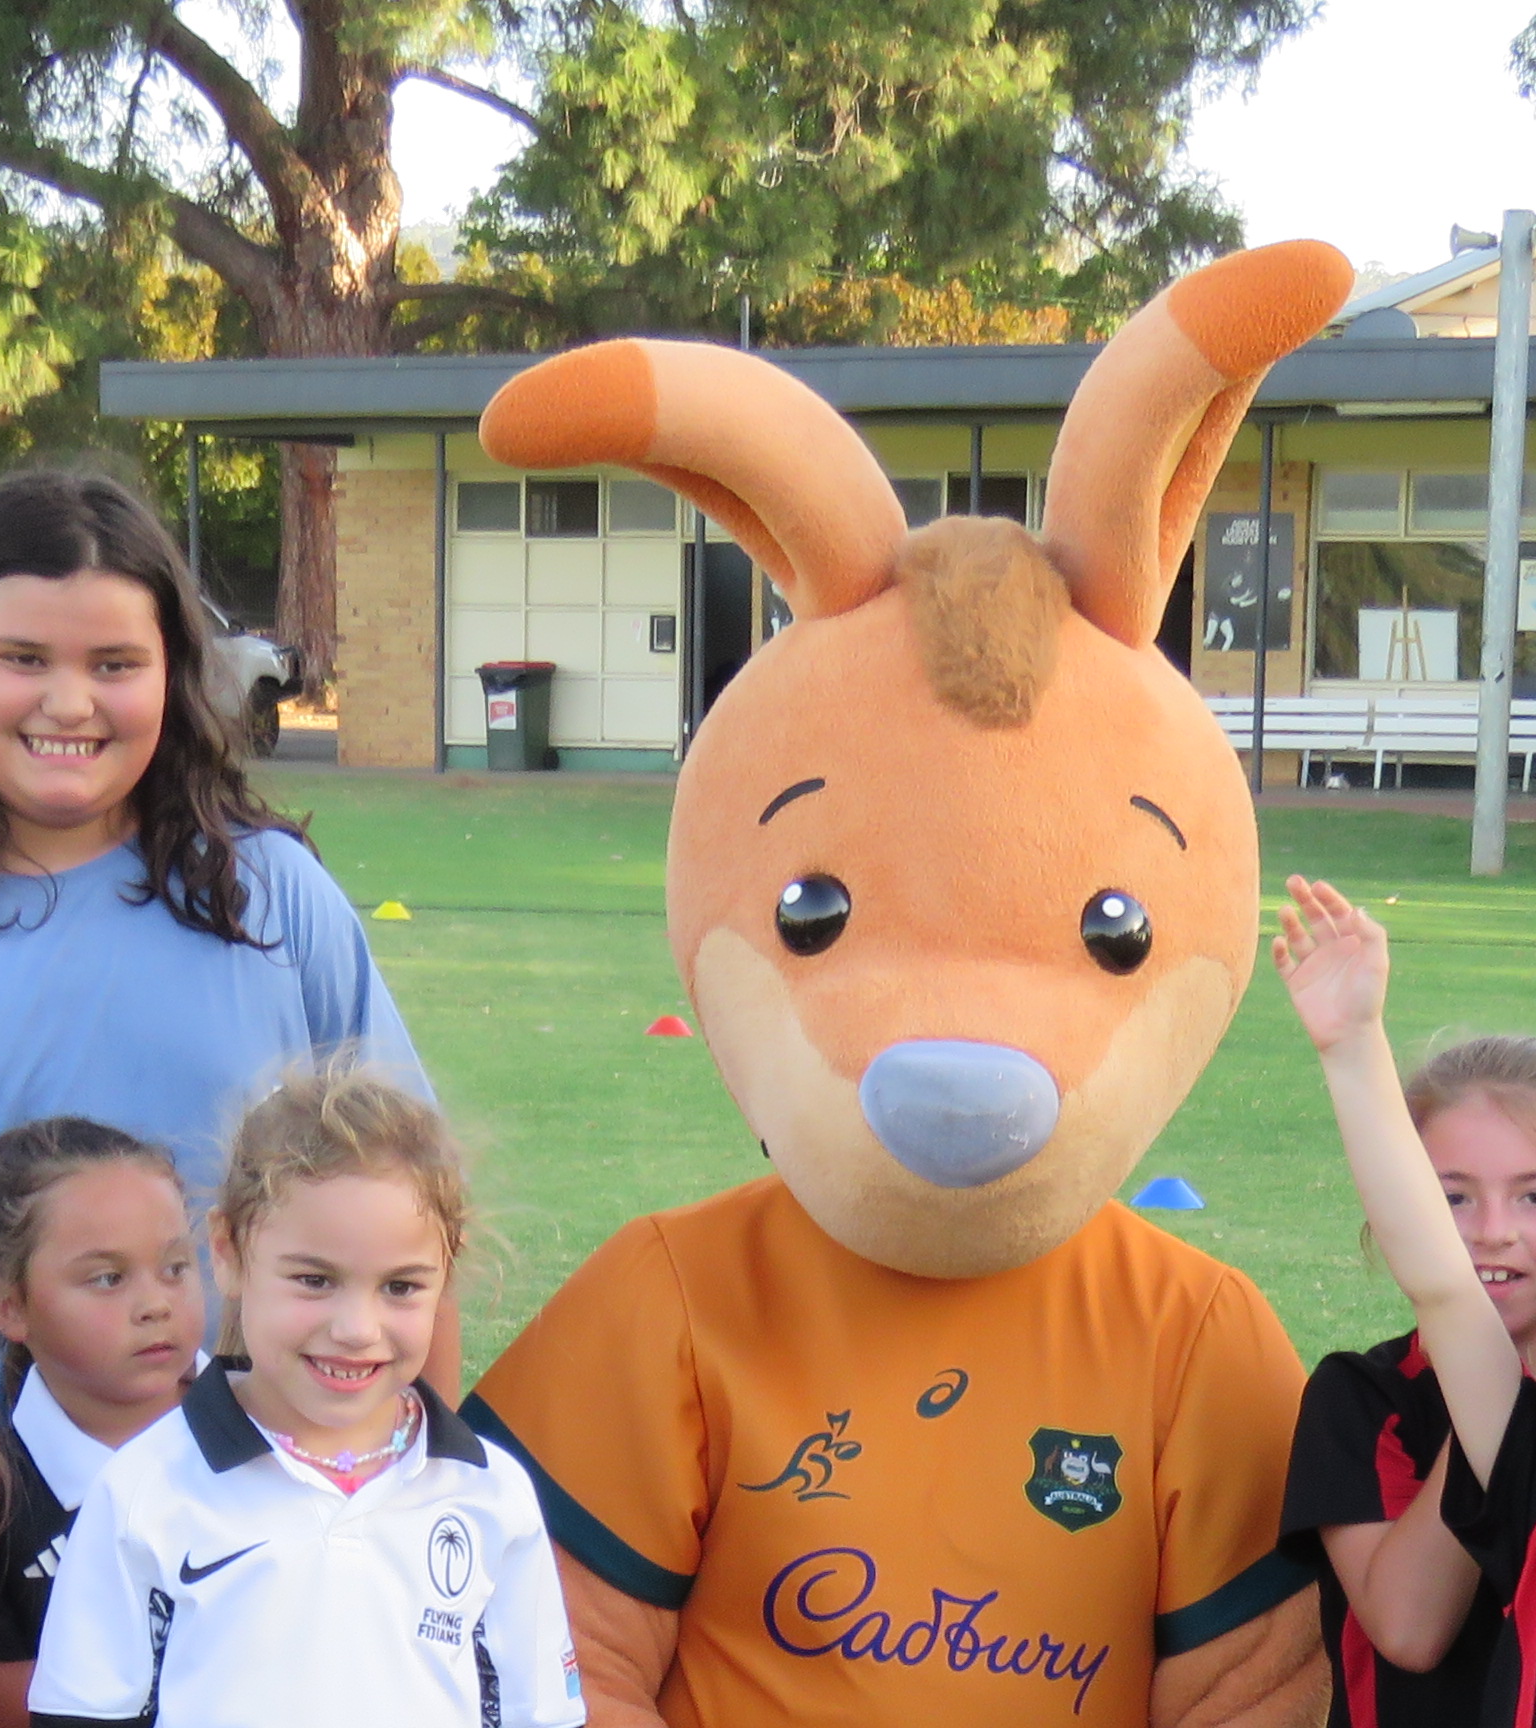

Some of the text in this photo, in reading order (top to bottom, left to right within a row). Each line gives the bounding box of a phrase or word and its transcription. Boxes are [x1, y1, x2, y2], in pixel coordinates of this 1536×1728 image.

[423, 1607, 463, 1630] FLYING
[417, 1623, 462, 1646] FIJIANS
[763, 1547, 1109, 1716] Cadbury
